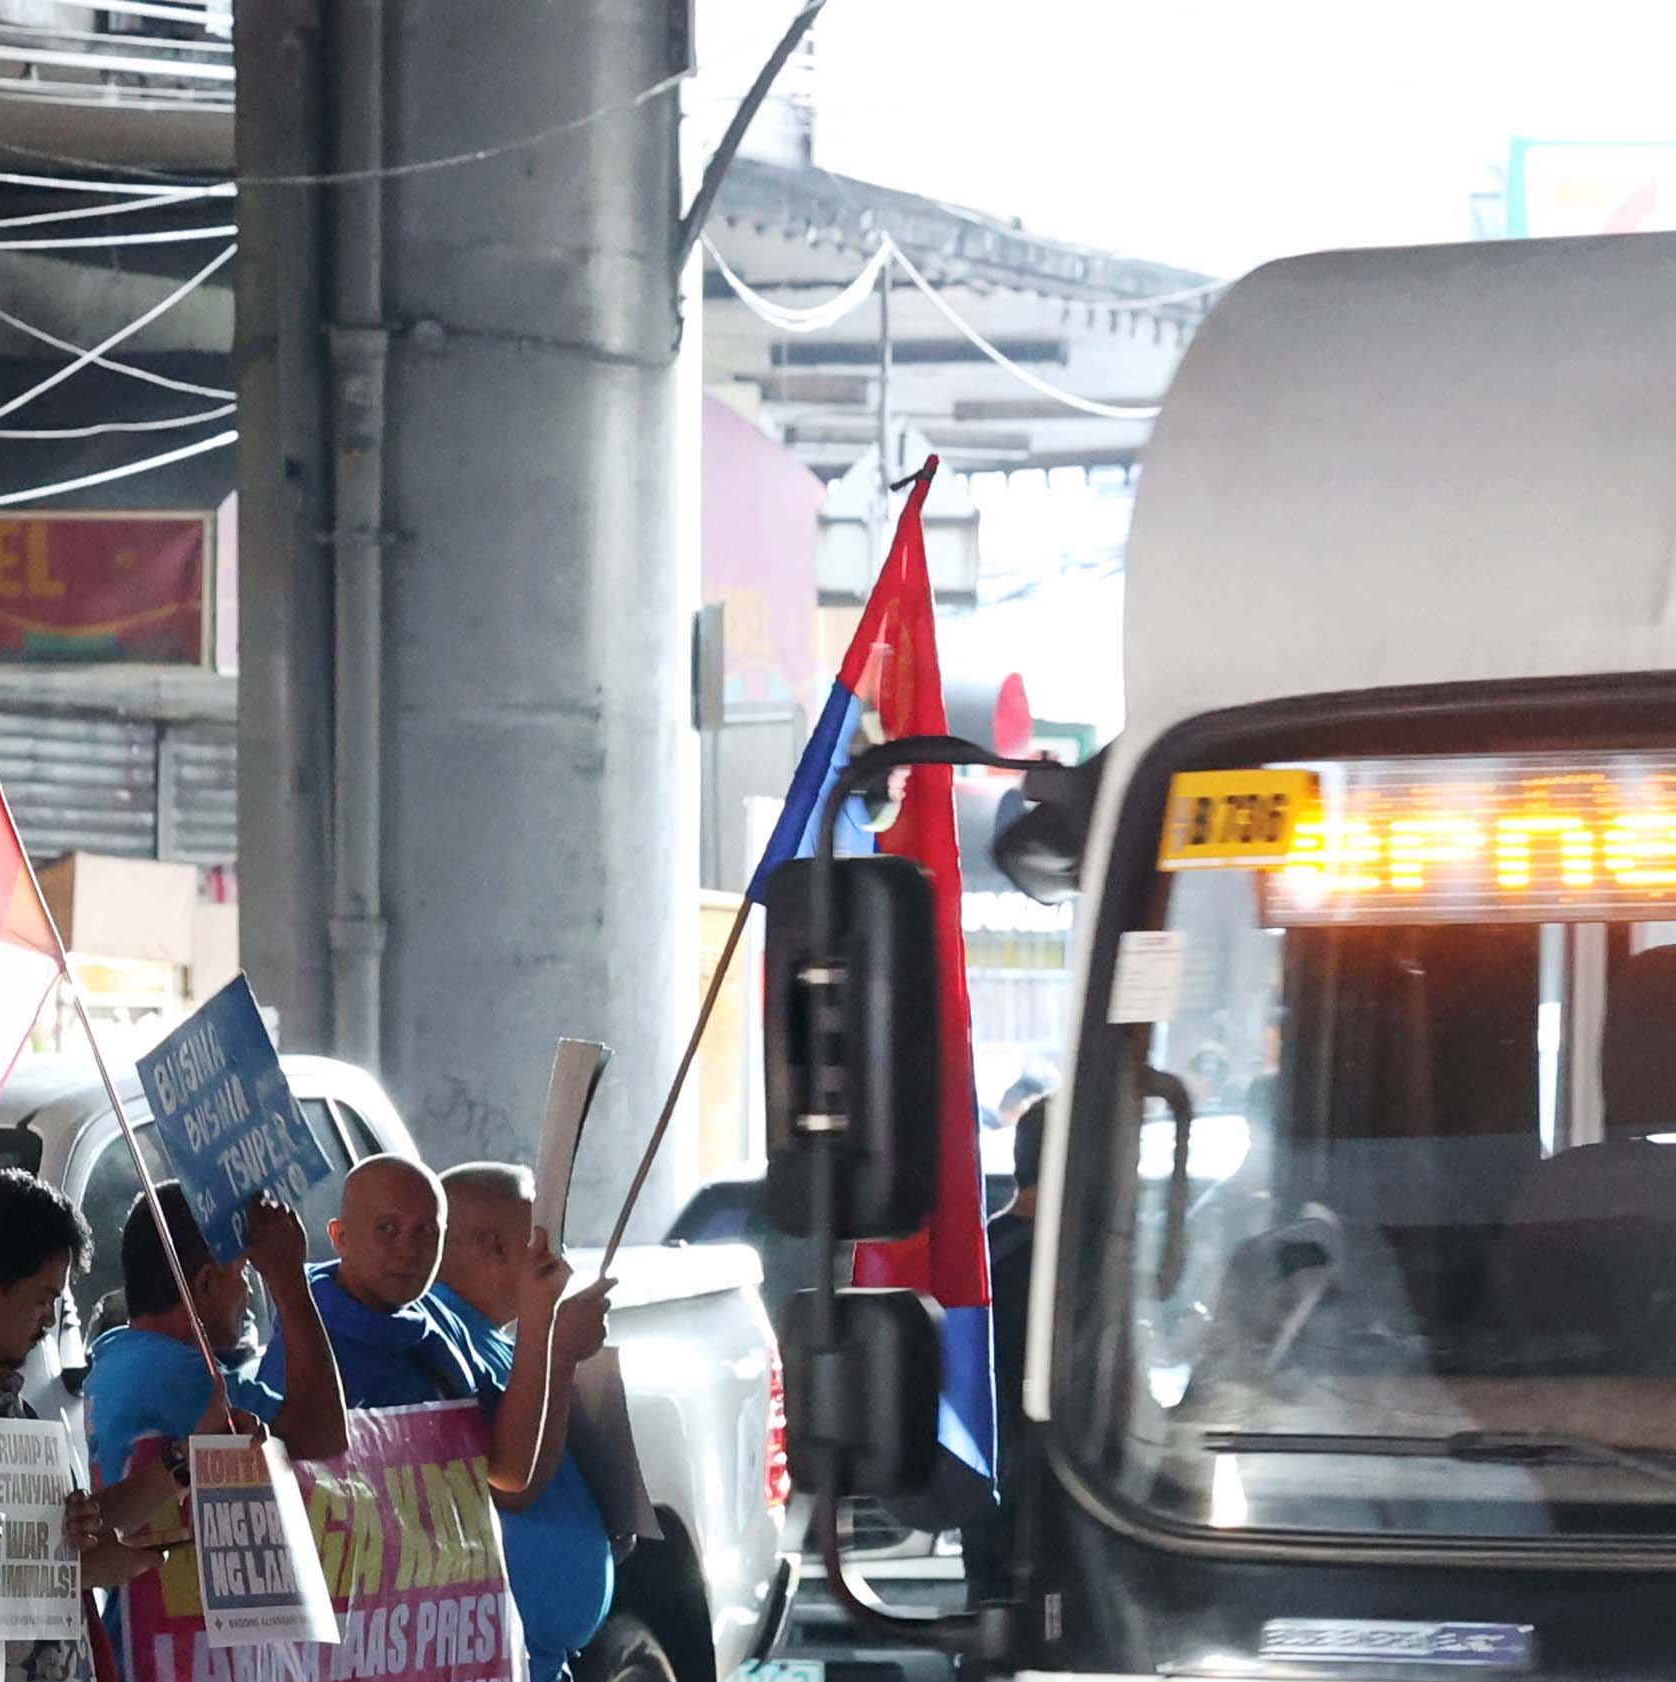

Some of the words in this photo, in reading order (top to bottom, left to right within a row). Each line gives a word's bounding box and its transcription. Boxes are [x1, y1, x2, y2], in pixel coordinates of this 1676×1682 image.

[6, 1520, 50, 1560] WAR
[203, 1502, 248, 1547] ANG
[210, 1551, 244, 1597] NG
